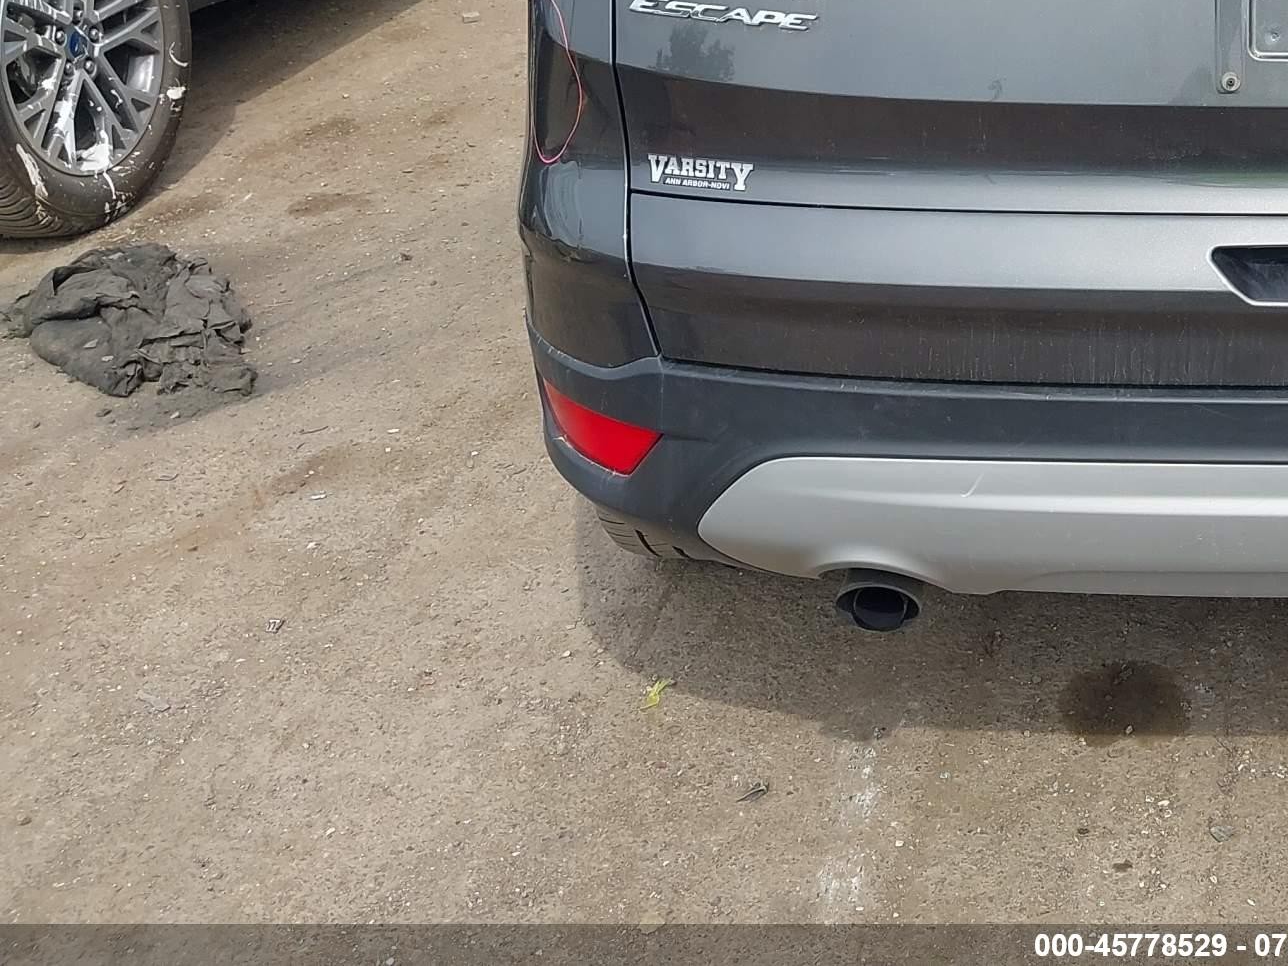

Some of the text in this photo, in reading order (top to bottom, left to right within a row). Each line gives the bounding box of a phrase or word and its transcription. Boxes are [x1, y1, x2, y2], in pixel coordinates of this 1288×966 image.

[648, 154, 754, 191] VARSITY
[665, 177, 731, 190] ANN ARBOR-NOVI
